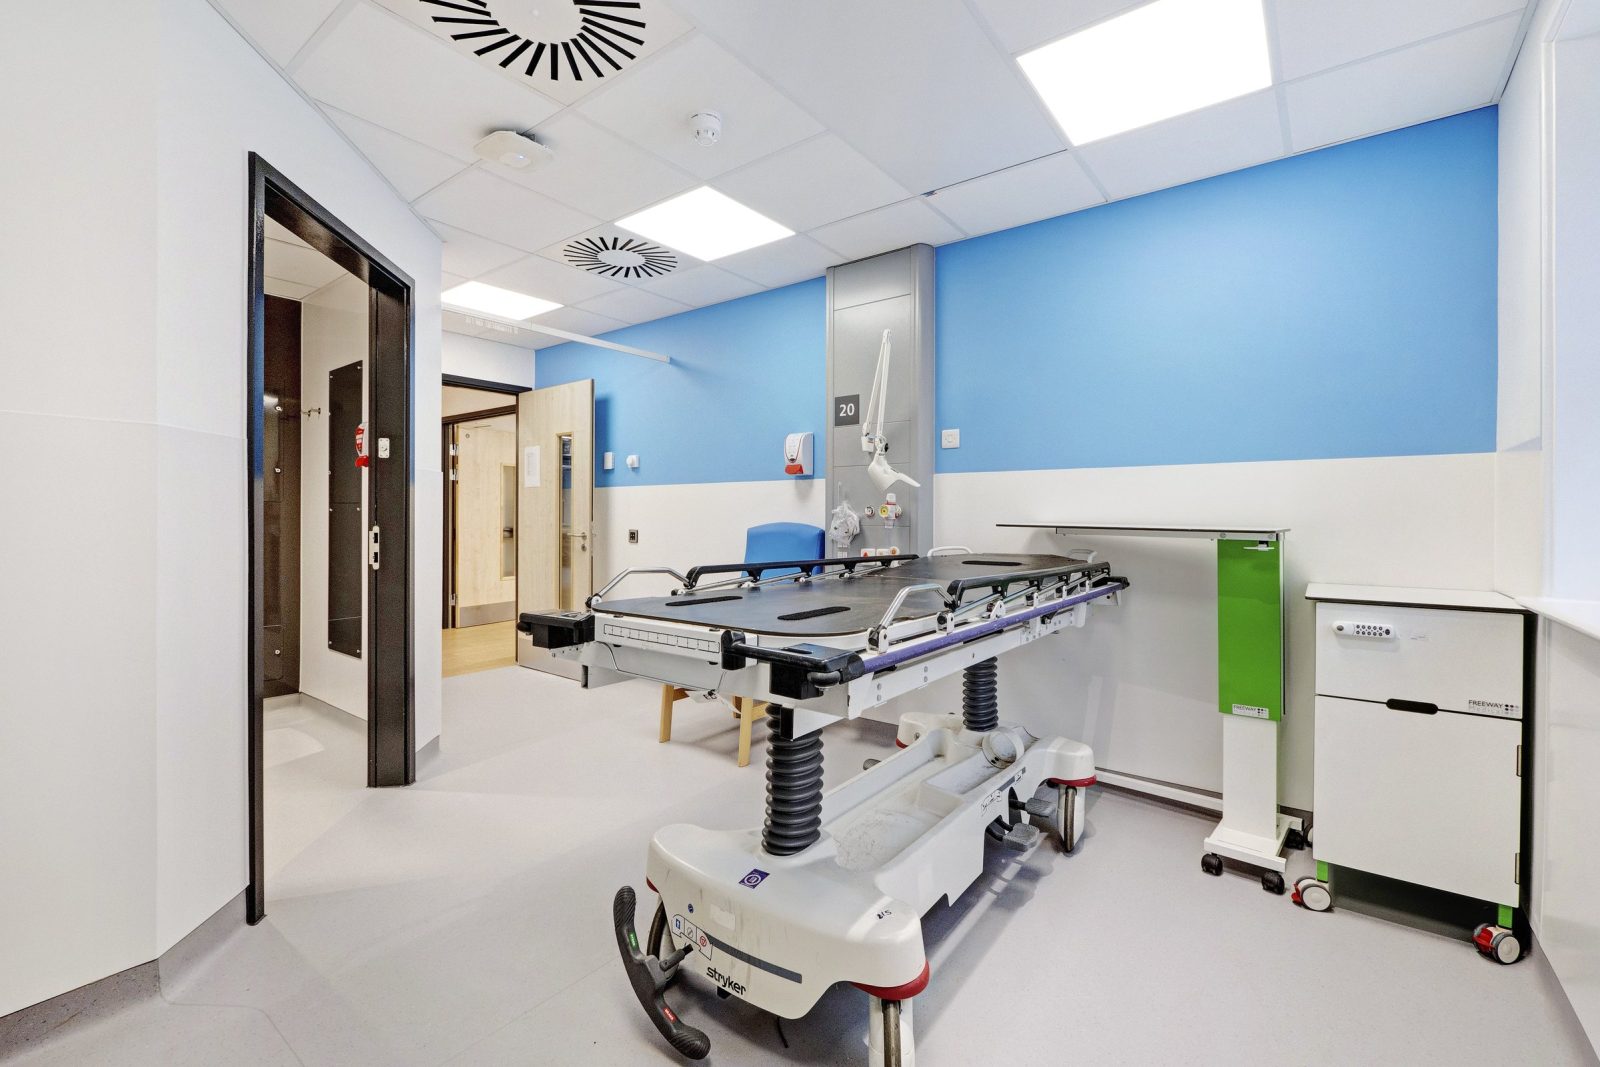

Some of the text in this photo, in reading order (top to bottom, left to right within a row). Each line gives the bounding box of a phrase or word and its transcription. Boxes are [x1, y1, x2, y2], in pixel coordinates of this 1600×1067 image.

[839, 403, 855, 417] 20
[1468, 699, 1504, 709] FREEWAY
[706, 966, 747, 995] stryker
